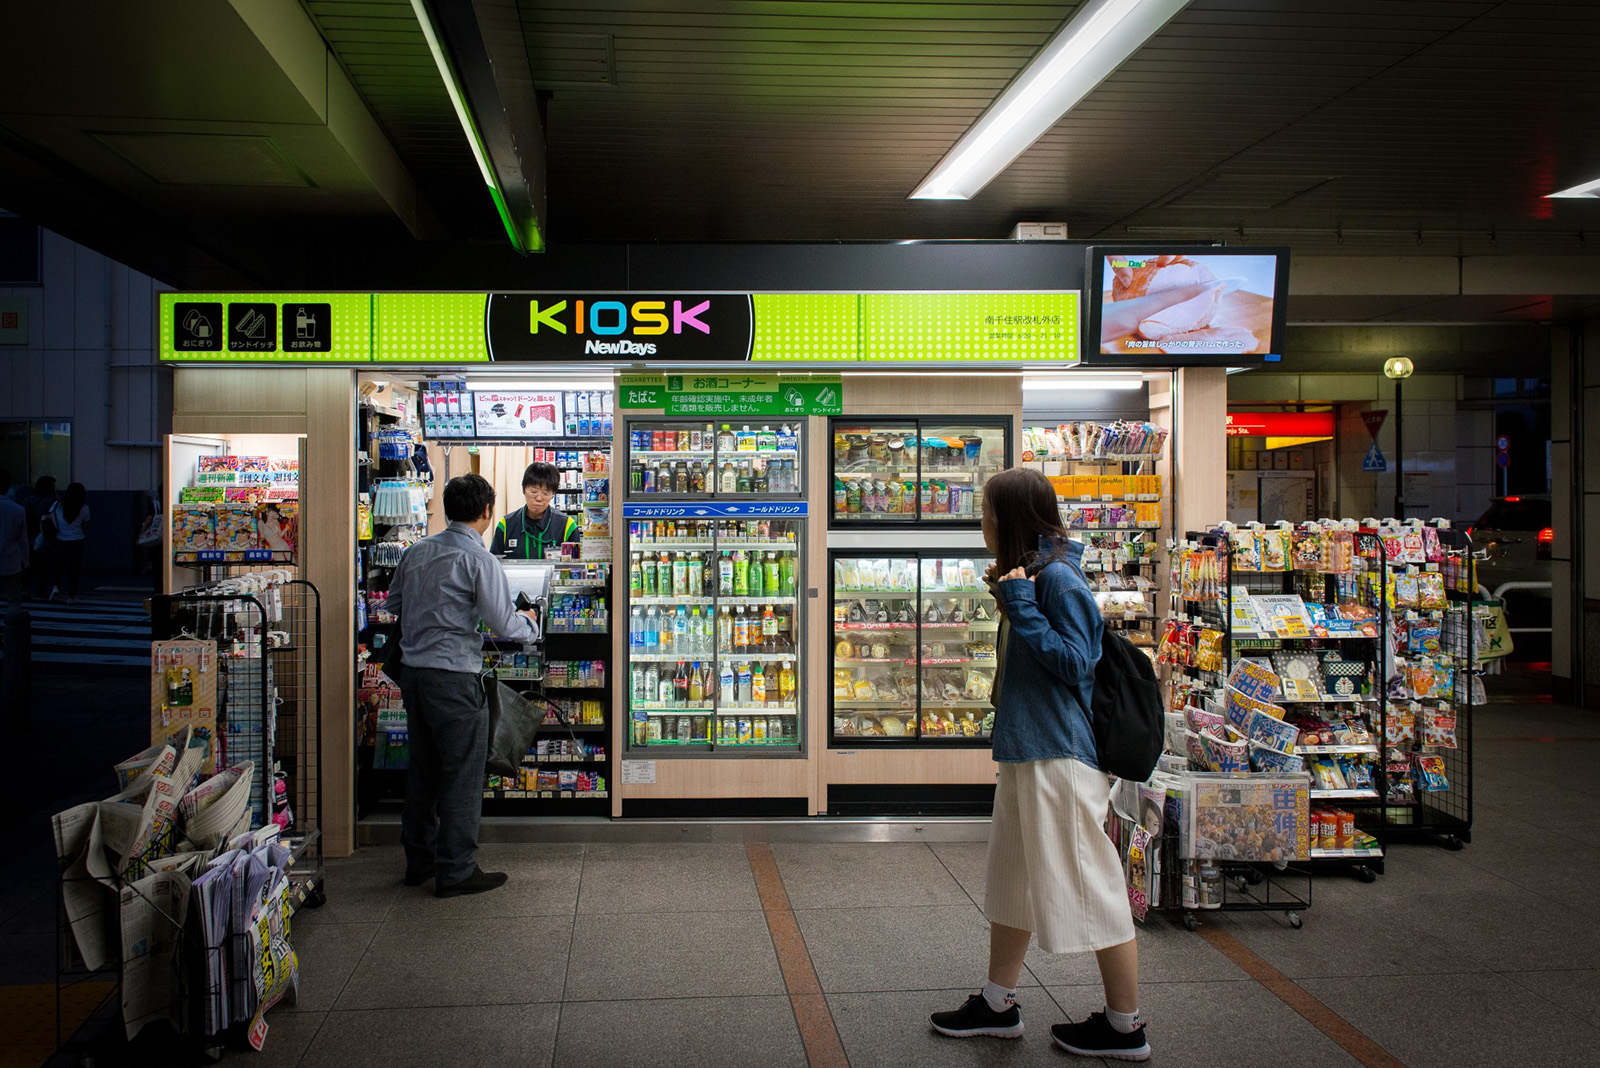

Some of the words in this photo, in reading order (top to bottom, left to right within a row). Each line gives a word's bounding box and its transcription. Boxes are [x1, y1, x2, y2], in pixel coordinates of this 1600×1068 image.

[1111, 259, 1146, 268] NewDays
[530, 300, 710, 335] KIOSK
[985, 315, 1060, 325] 南千住駅改札外店
[585, 340, 657, 355] NewDays
[693, 377, 766, 389] お酒コーナー
[628, 391, 656, 403] たばこ
[671, 395, 772, 403] 年齢確認実施中。未成年者
[671, 404, 760, 413] に酒類を販売しません。
[198, 473, 236, 483] 週刊新潮
[633, 508, 685, 516] コールドドリンク
[1128, 887, 1146, 905] 320
